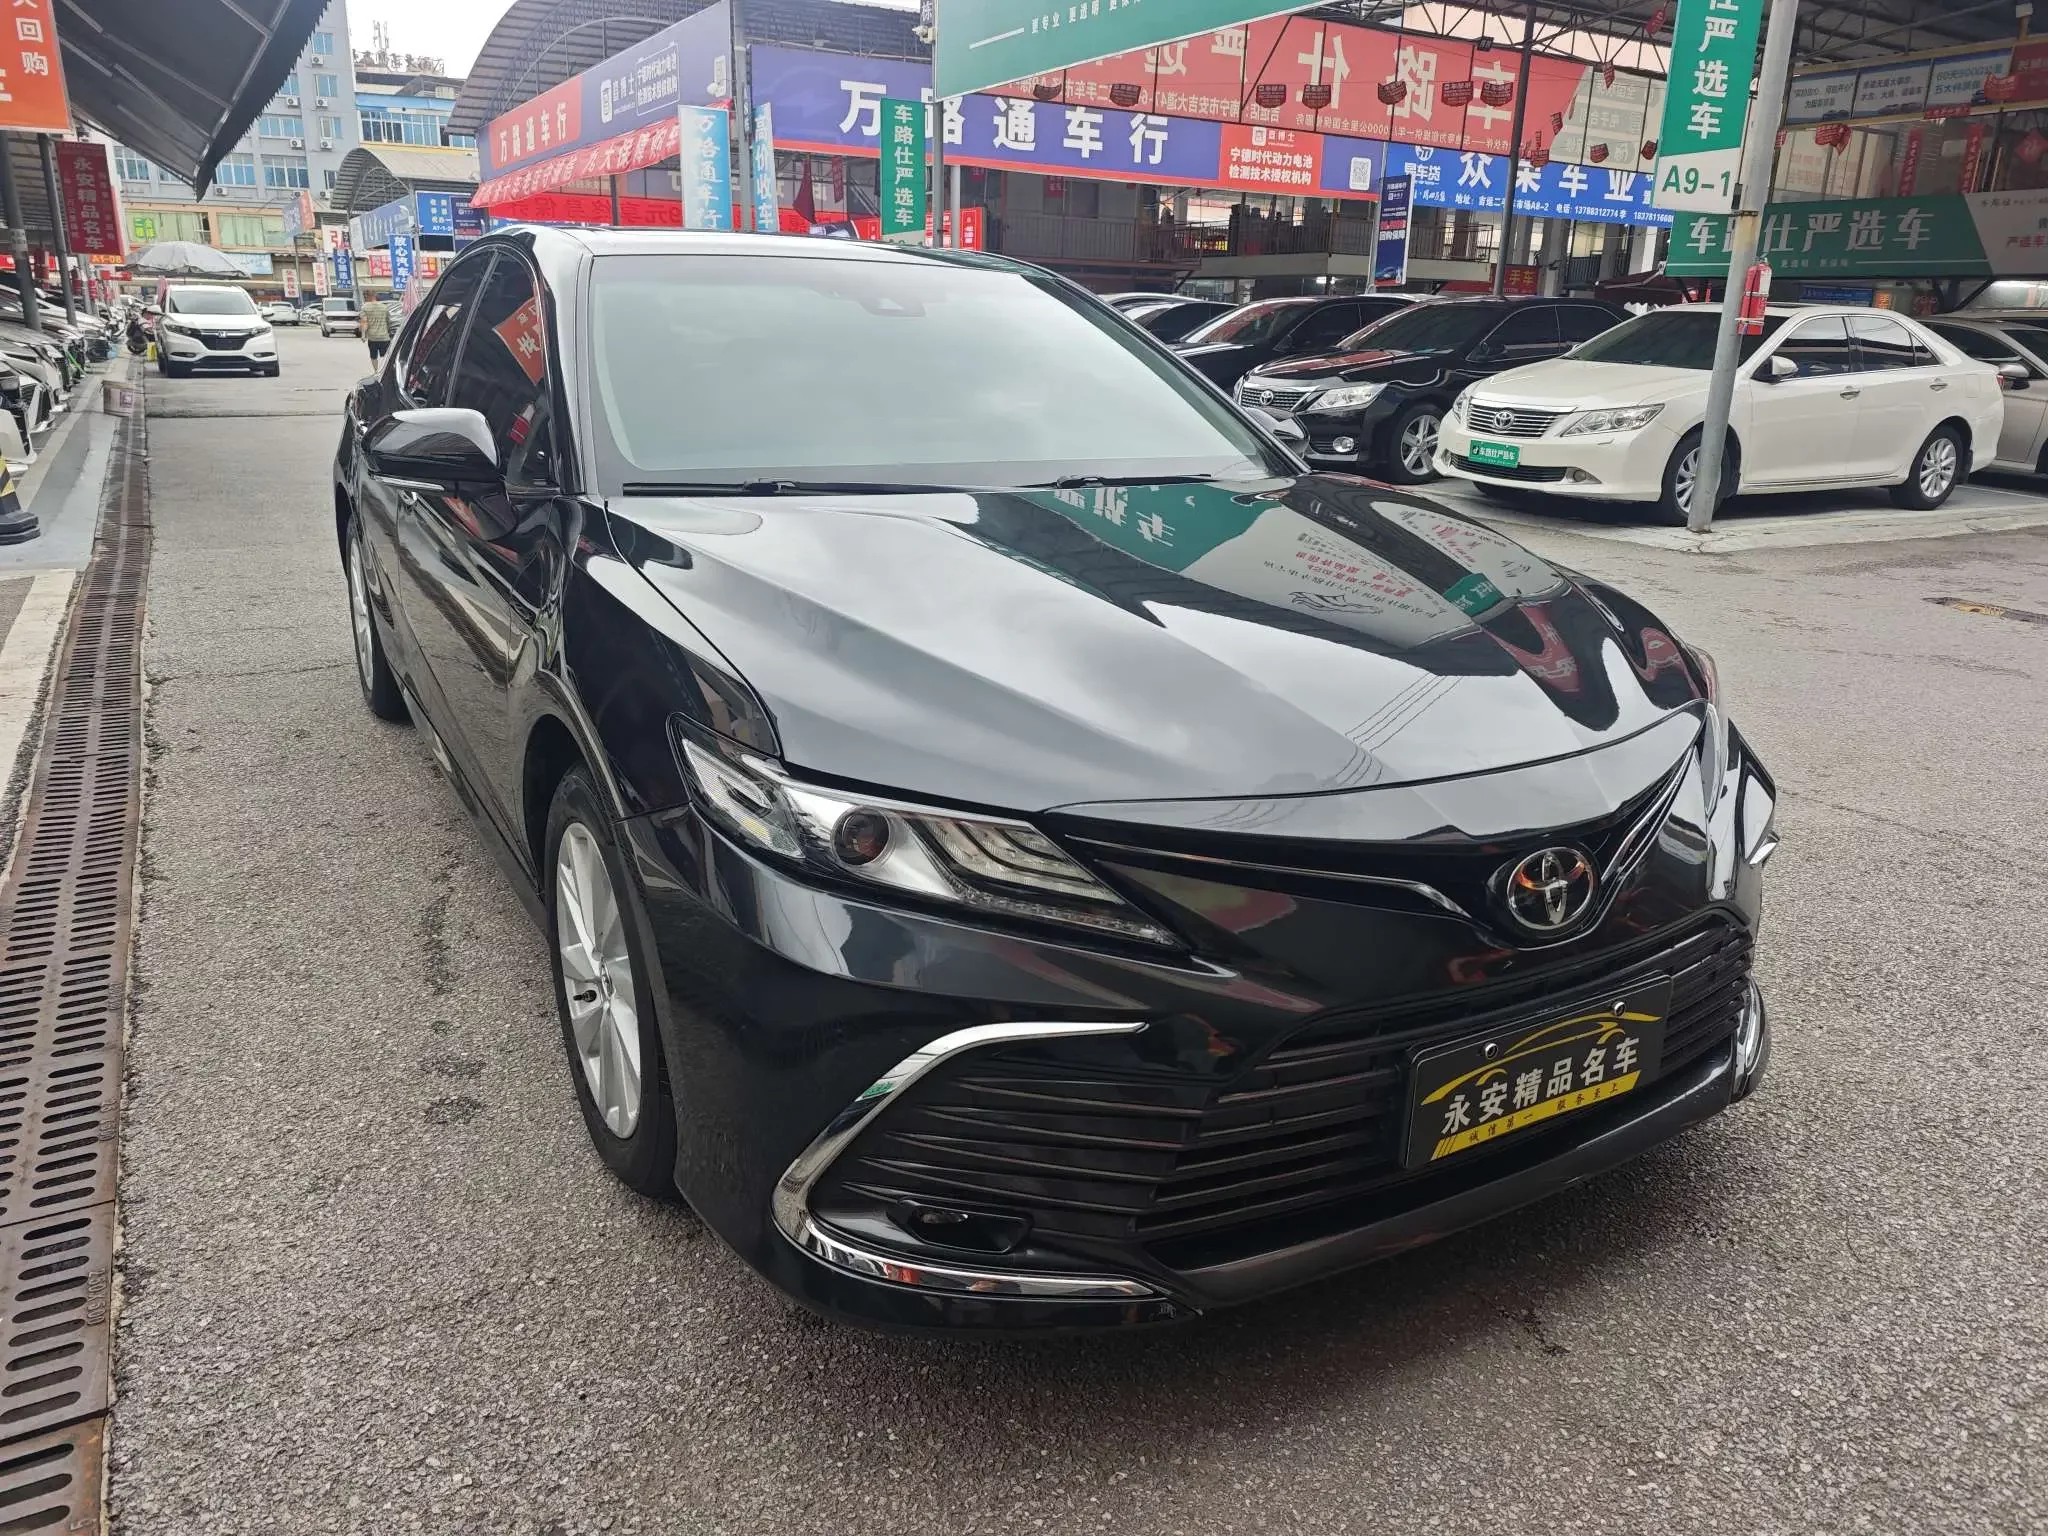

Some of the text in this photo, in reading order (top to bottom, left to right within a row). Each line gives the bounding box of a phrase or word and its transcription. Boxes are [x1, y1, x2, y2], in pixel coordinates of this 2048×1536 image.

[500, 102, 567, 162] 万路通车行
[893, 104, 915, 227] 车路仕严选车
[1231, 147, 1313, 169] 宁德时代动力电池
[73, 156, 104, 250] 永安精品名车
[693, 114, 722, 229] 万路通车行
[754, 115, 776, 232] 高价收车
[1229, 164, 1312, 185] 检测技术授权机构
[1662, 165, 1732, 197] A9-1
[1441, 1037, 1640, 1135] 永安精品名车
[1468, 1083, 1619, 1143] 诚信第一 服务至上
